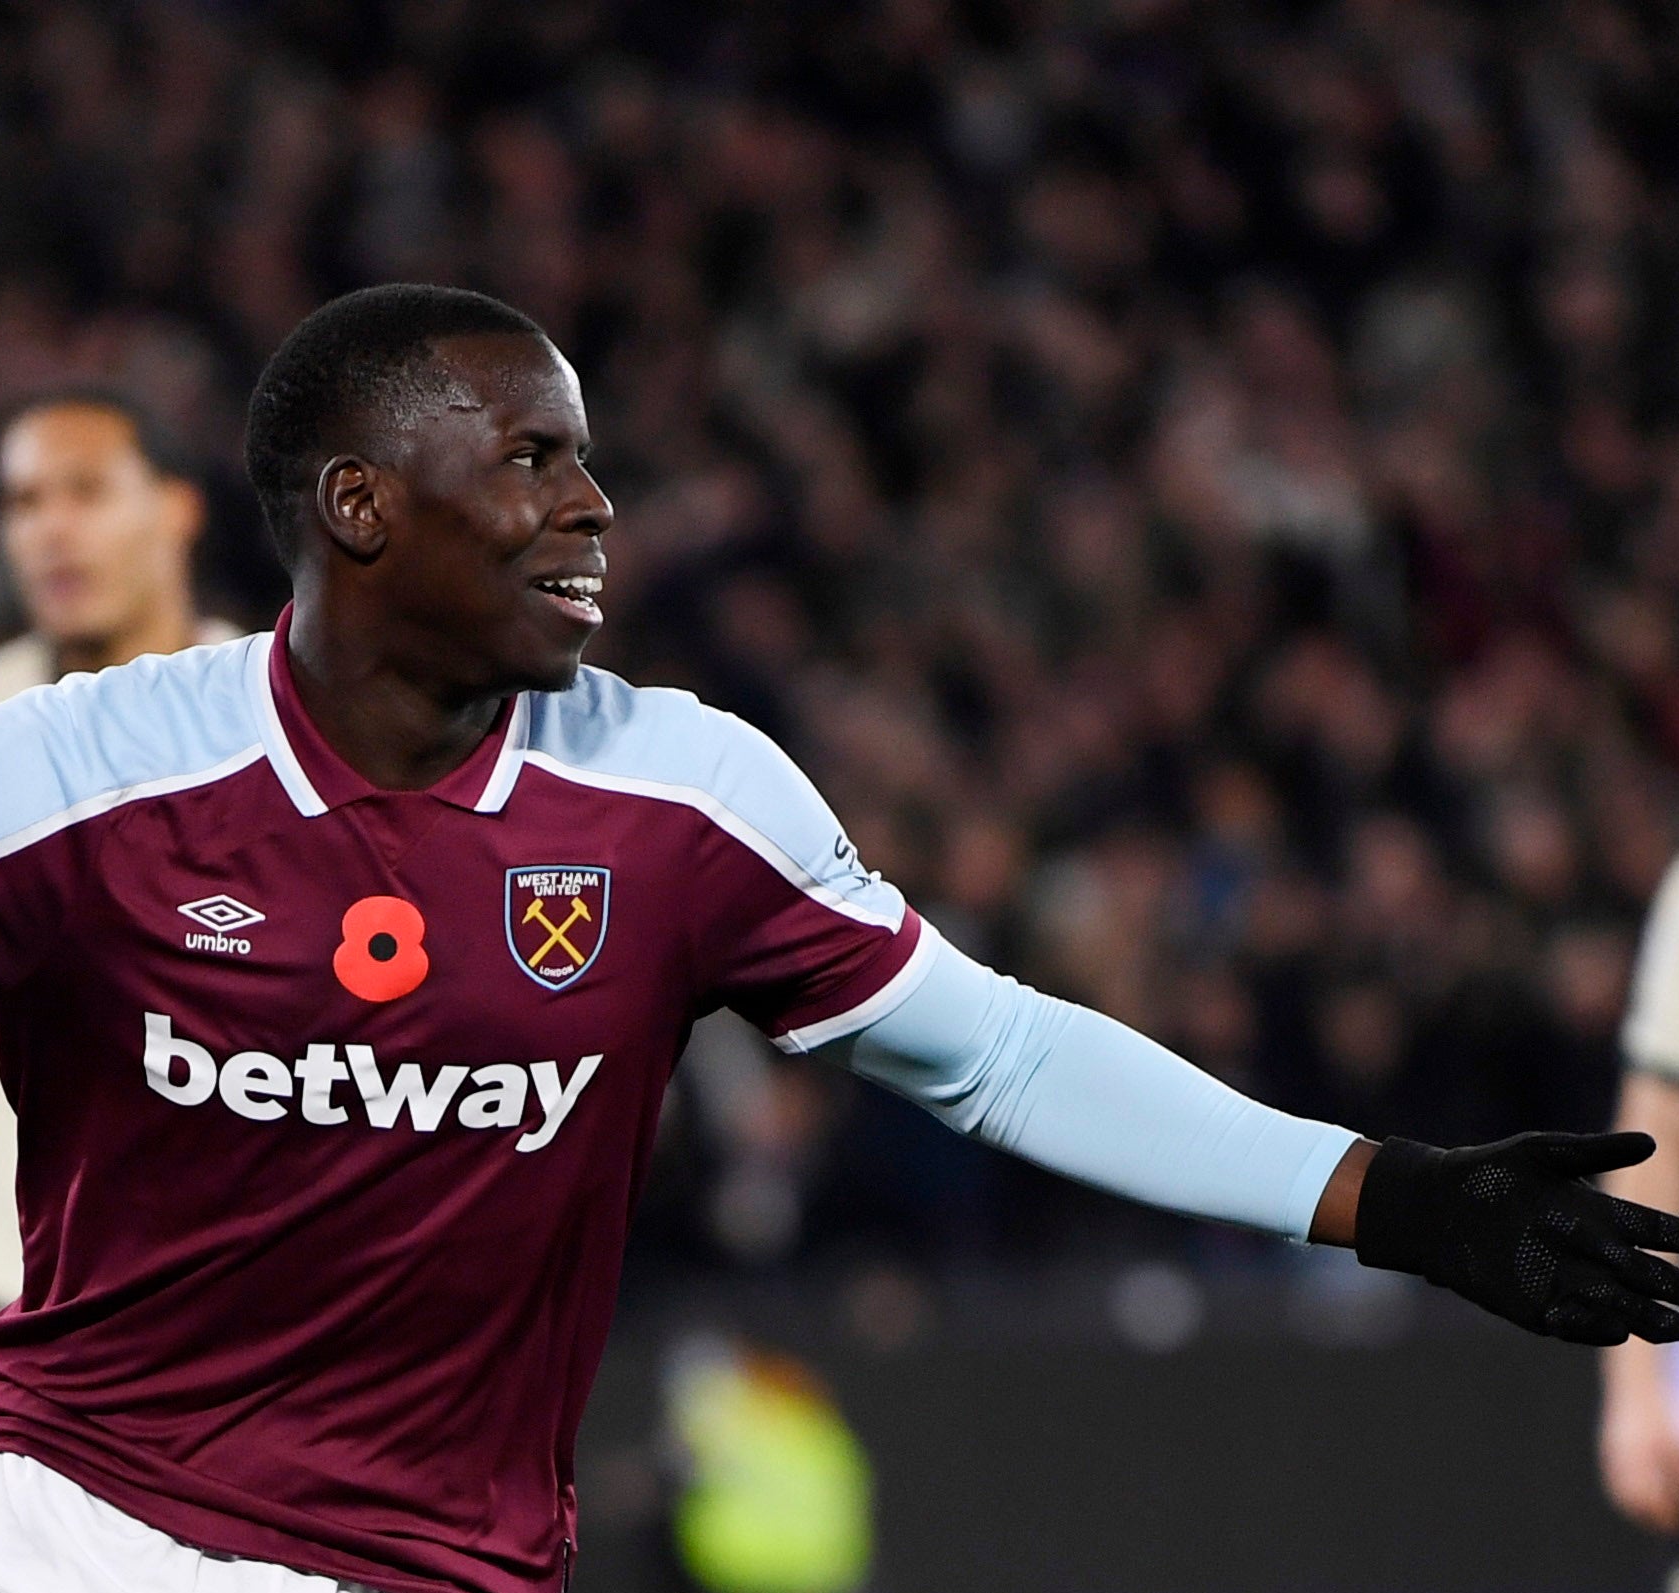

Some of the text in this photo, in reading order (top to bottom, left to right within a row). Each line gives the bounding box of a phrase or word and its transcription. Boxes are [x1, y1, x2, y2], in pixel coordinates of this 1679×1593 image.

[516, 871, 599, 888] WEST HAM
[533, 884, 582, 897] UNITED
[185, 932, 251, 954] umbro
[538, 964, 575, 977] LONDON
[144, 1012, 603, 1153] betway
